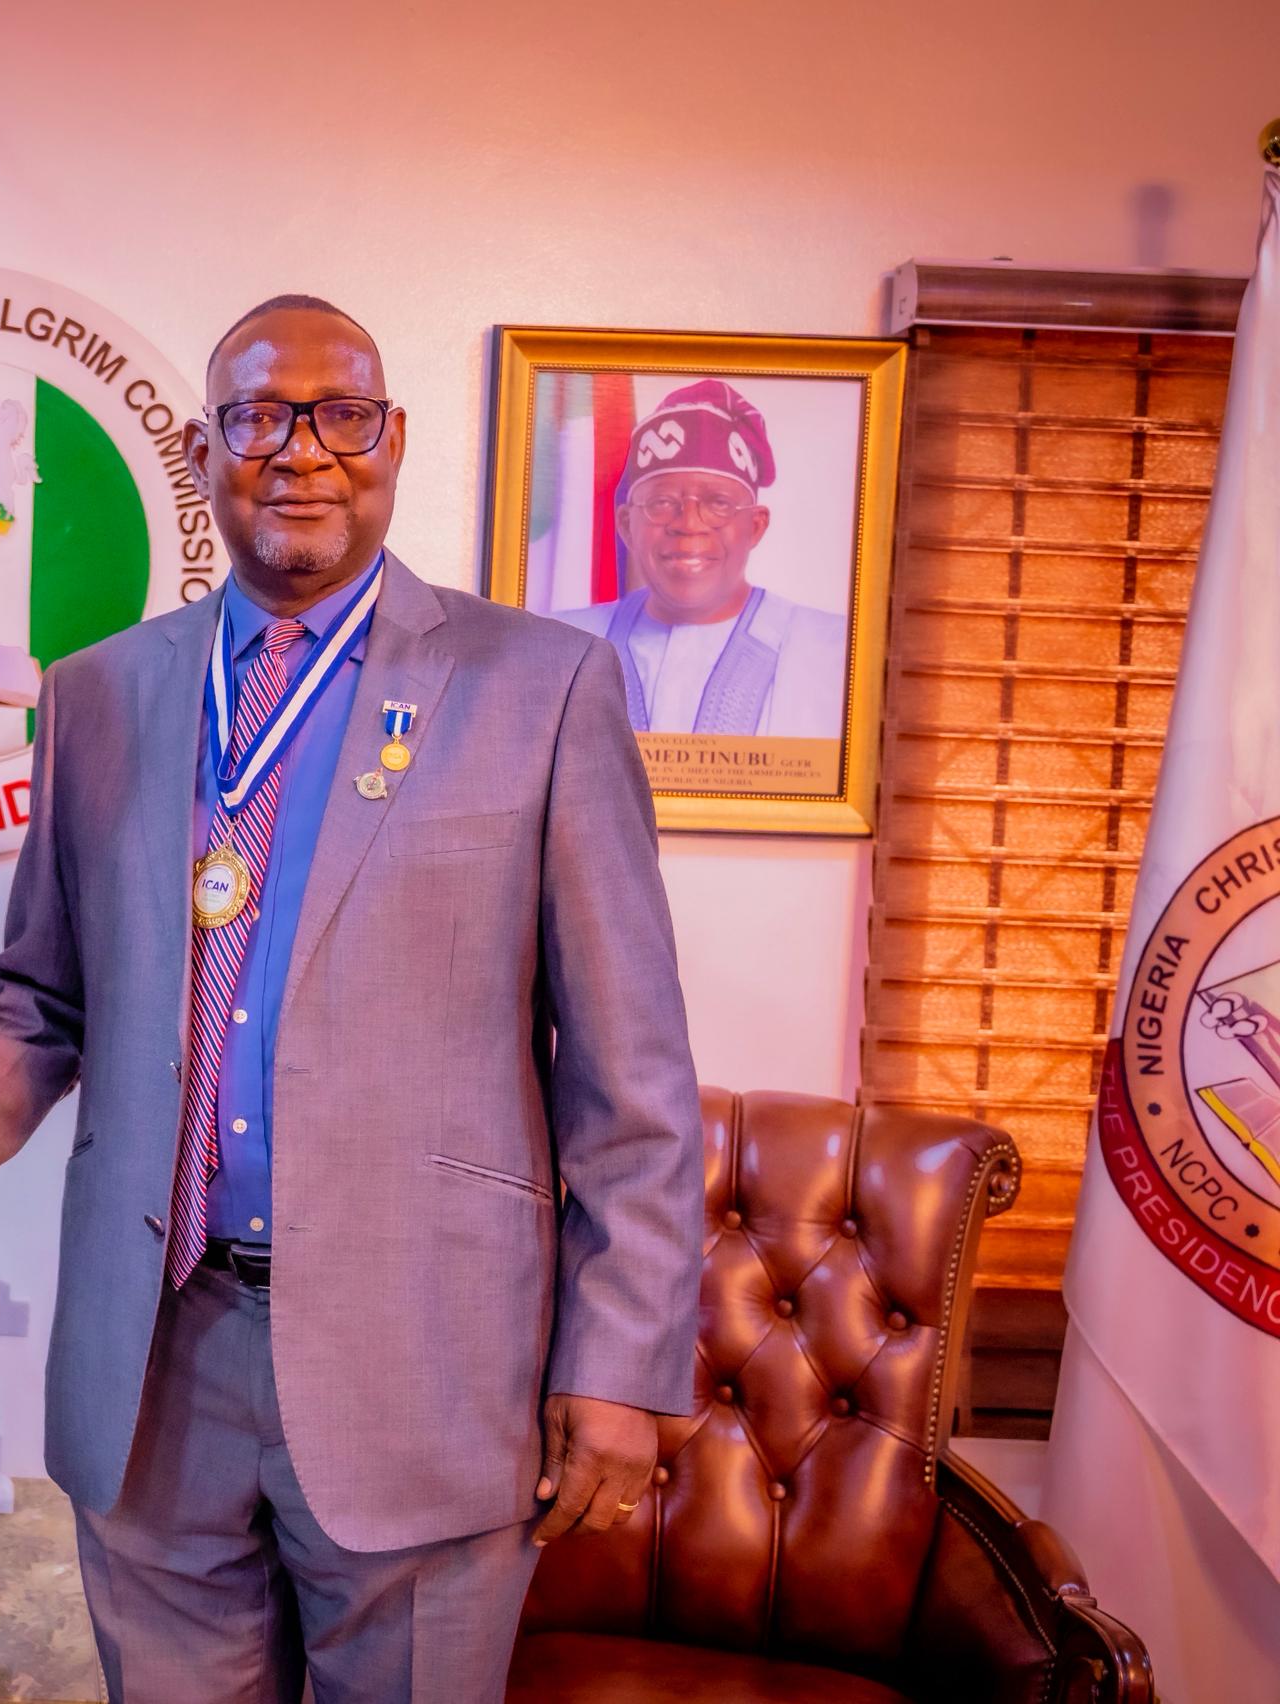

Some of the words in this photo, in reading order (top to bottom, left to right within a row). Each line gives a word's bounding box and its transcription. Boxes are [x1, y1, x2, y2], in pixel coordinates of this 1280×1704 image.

[695, 750, 776, 767] TINUBU
[202, 878, 230, 893] ICAN
[1136, 934, 1190, 1076] NIGERIA
[1103, 1063, 1126, 1135] THE
[1160, 1138, 1239, 1221] NCPC
